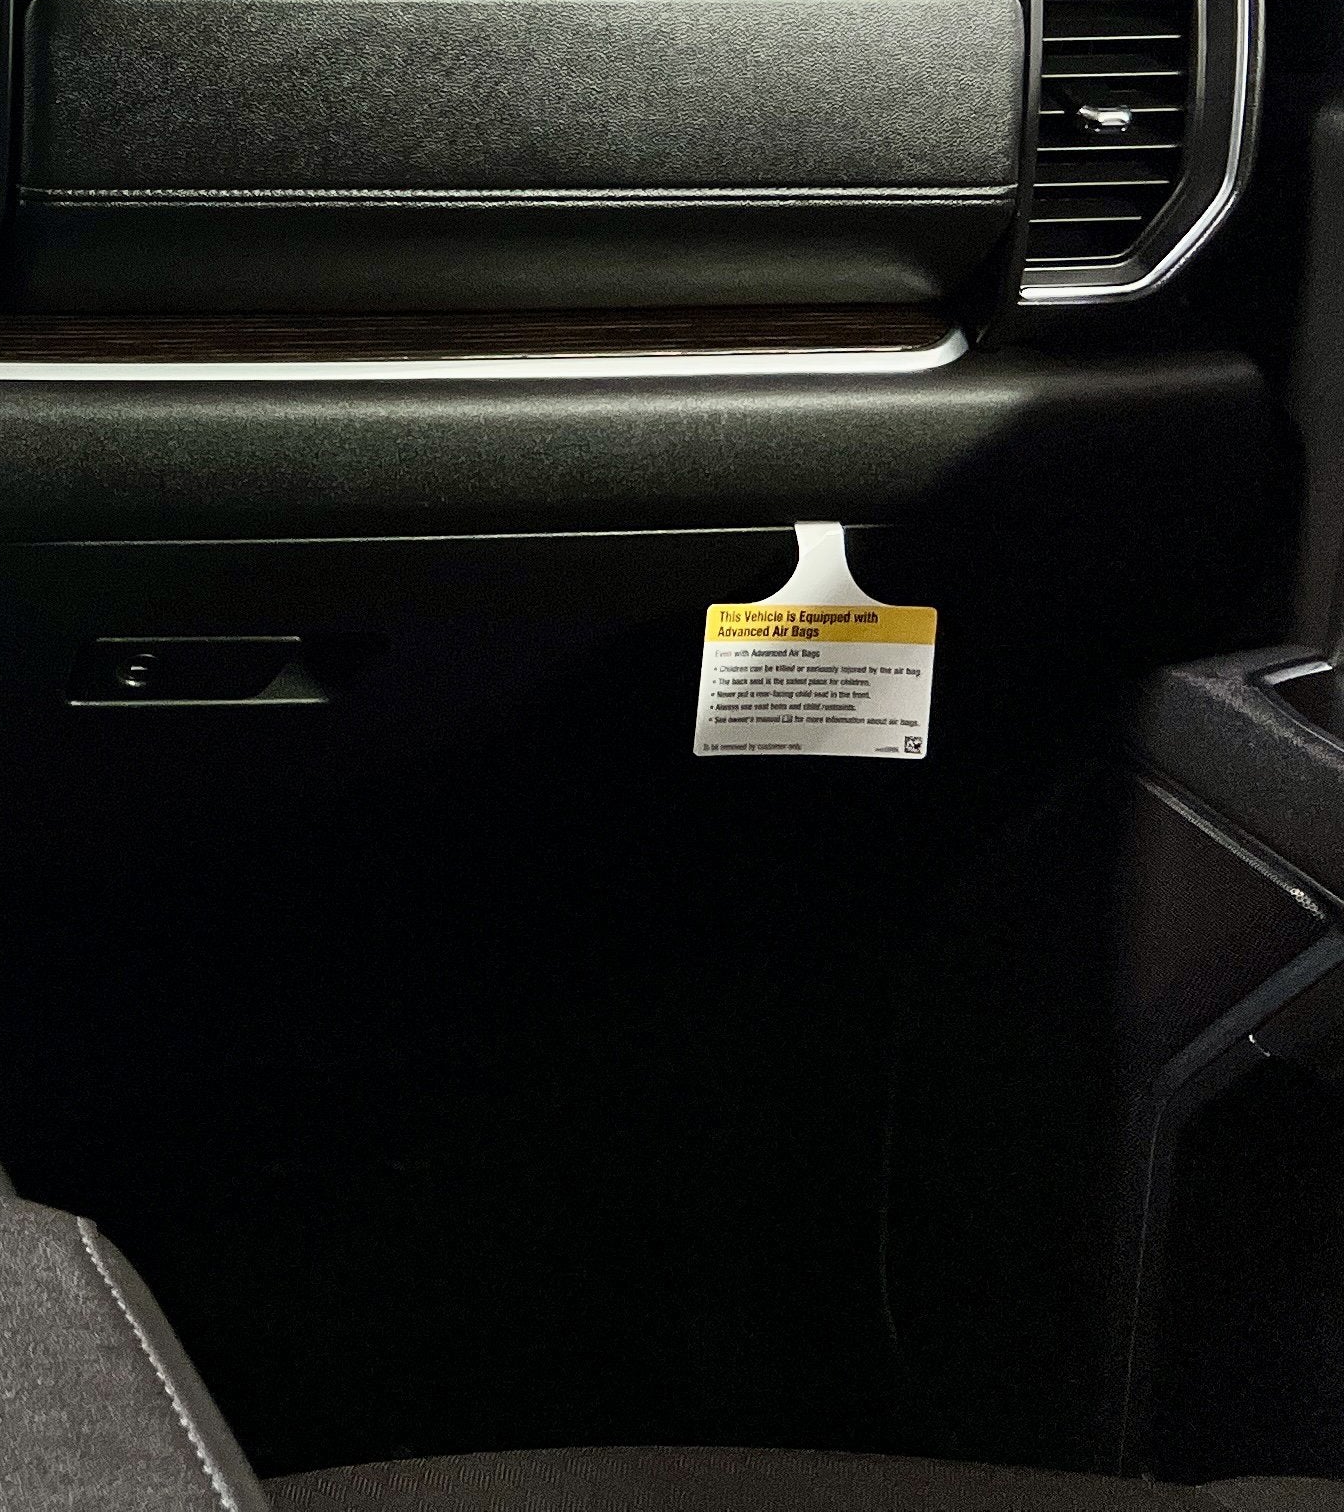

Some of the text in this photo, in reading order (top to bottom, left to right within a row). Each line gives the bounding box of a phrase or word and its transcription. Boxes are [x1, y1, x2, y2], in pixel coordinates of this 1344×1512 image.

[720, 610, 879, 624] This Vehicle is Equipped with
[718, 626, 820, 639] Advanced Air Bags
[734, 649, 749, 657] with
[751, 648, 787, 657] Advanced
[789, 648, 799, 657] Air
[801, 649, 820, 659] Bags
